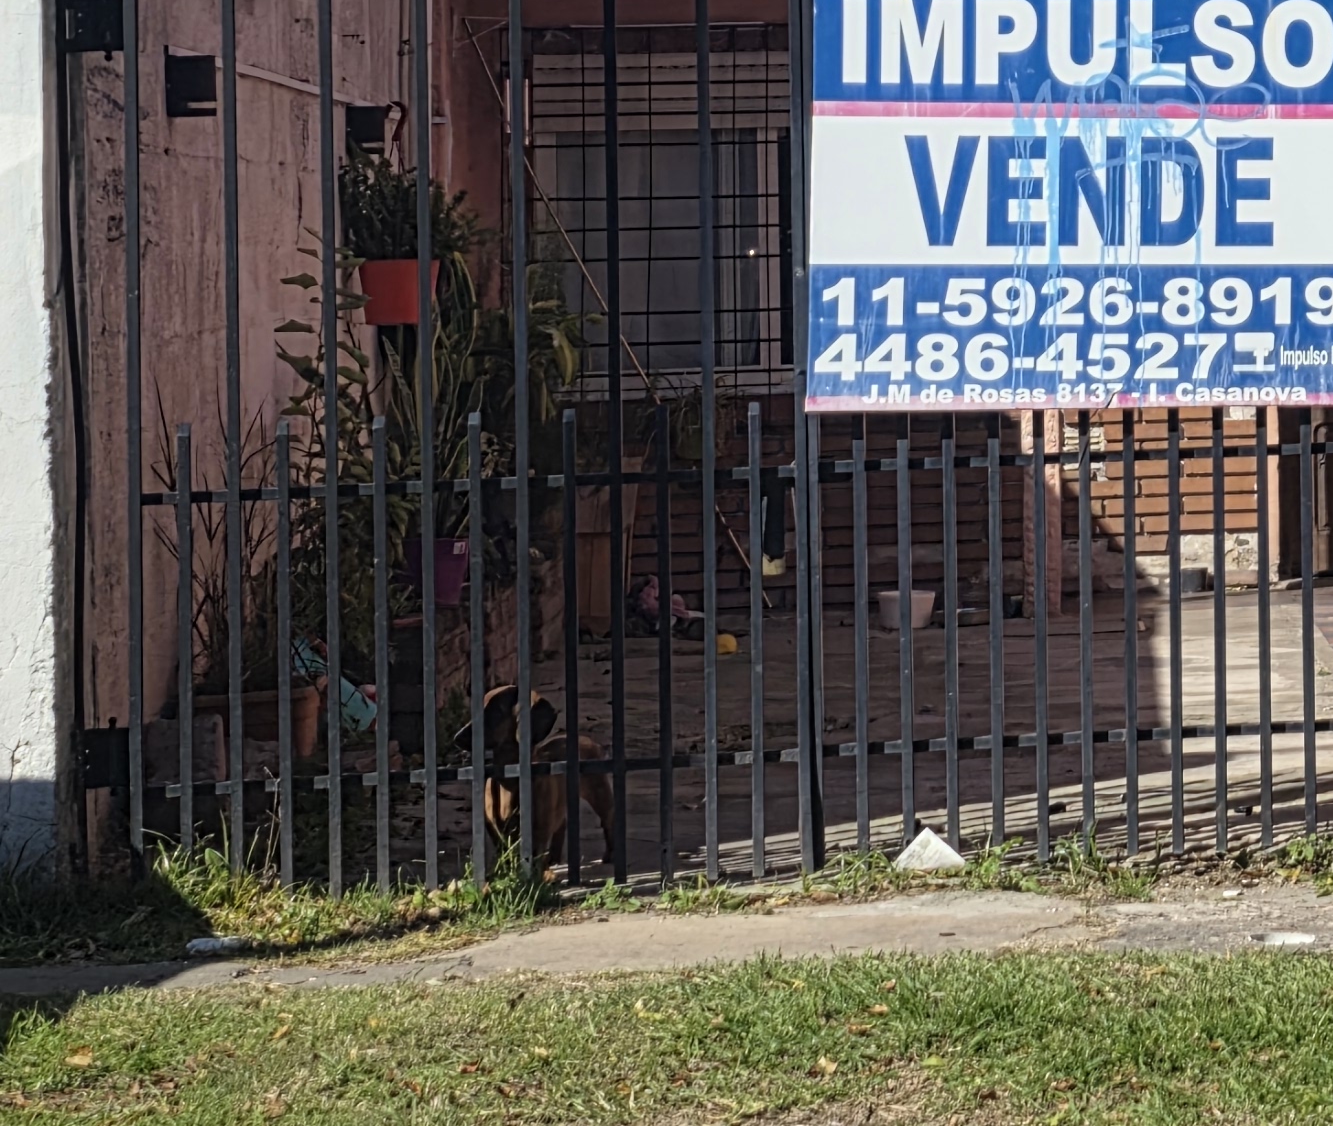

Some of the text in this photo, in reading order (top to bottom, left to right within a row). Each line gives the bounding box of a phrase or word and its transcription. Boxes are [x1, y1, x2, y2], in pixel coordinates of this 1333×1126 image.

[904, 135, 1275, 248] VENDE
[814, 332, 1228, 381] 4486-4527
[1280, 345, 1328, 371] Impulso
[862, 384, 911, 404] J.M
[919, 384, 955, 404] de
[963, 384, 1047, 404] Rosas
[1056, 382, 1124, 404] 8137
[1175, 382, 1307, 403] Casanova
